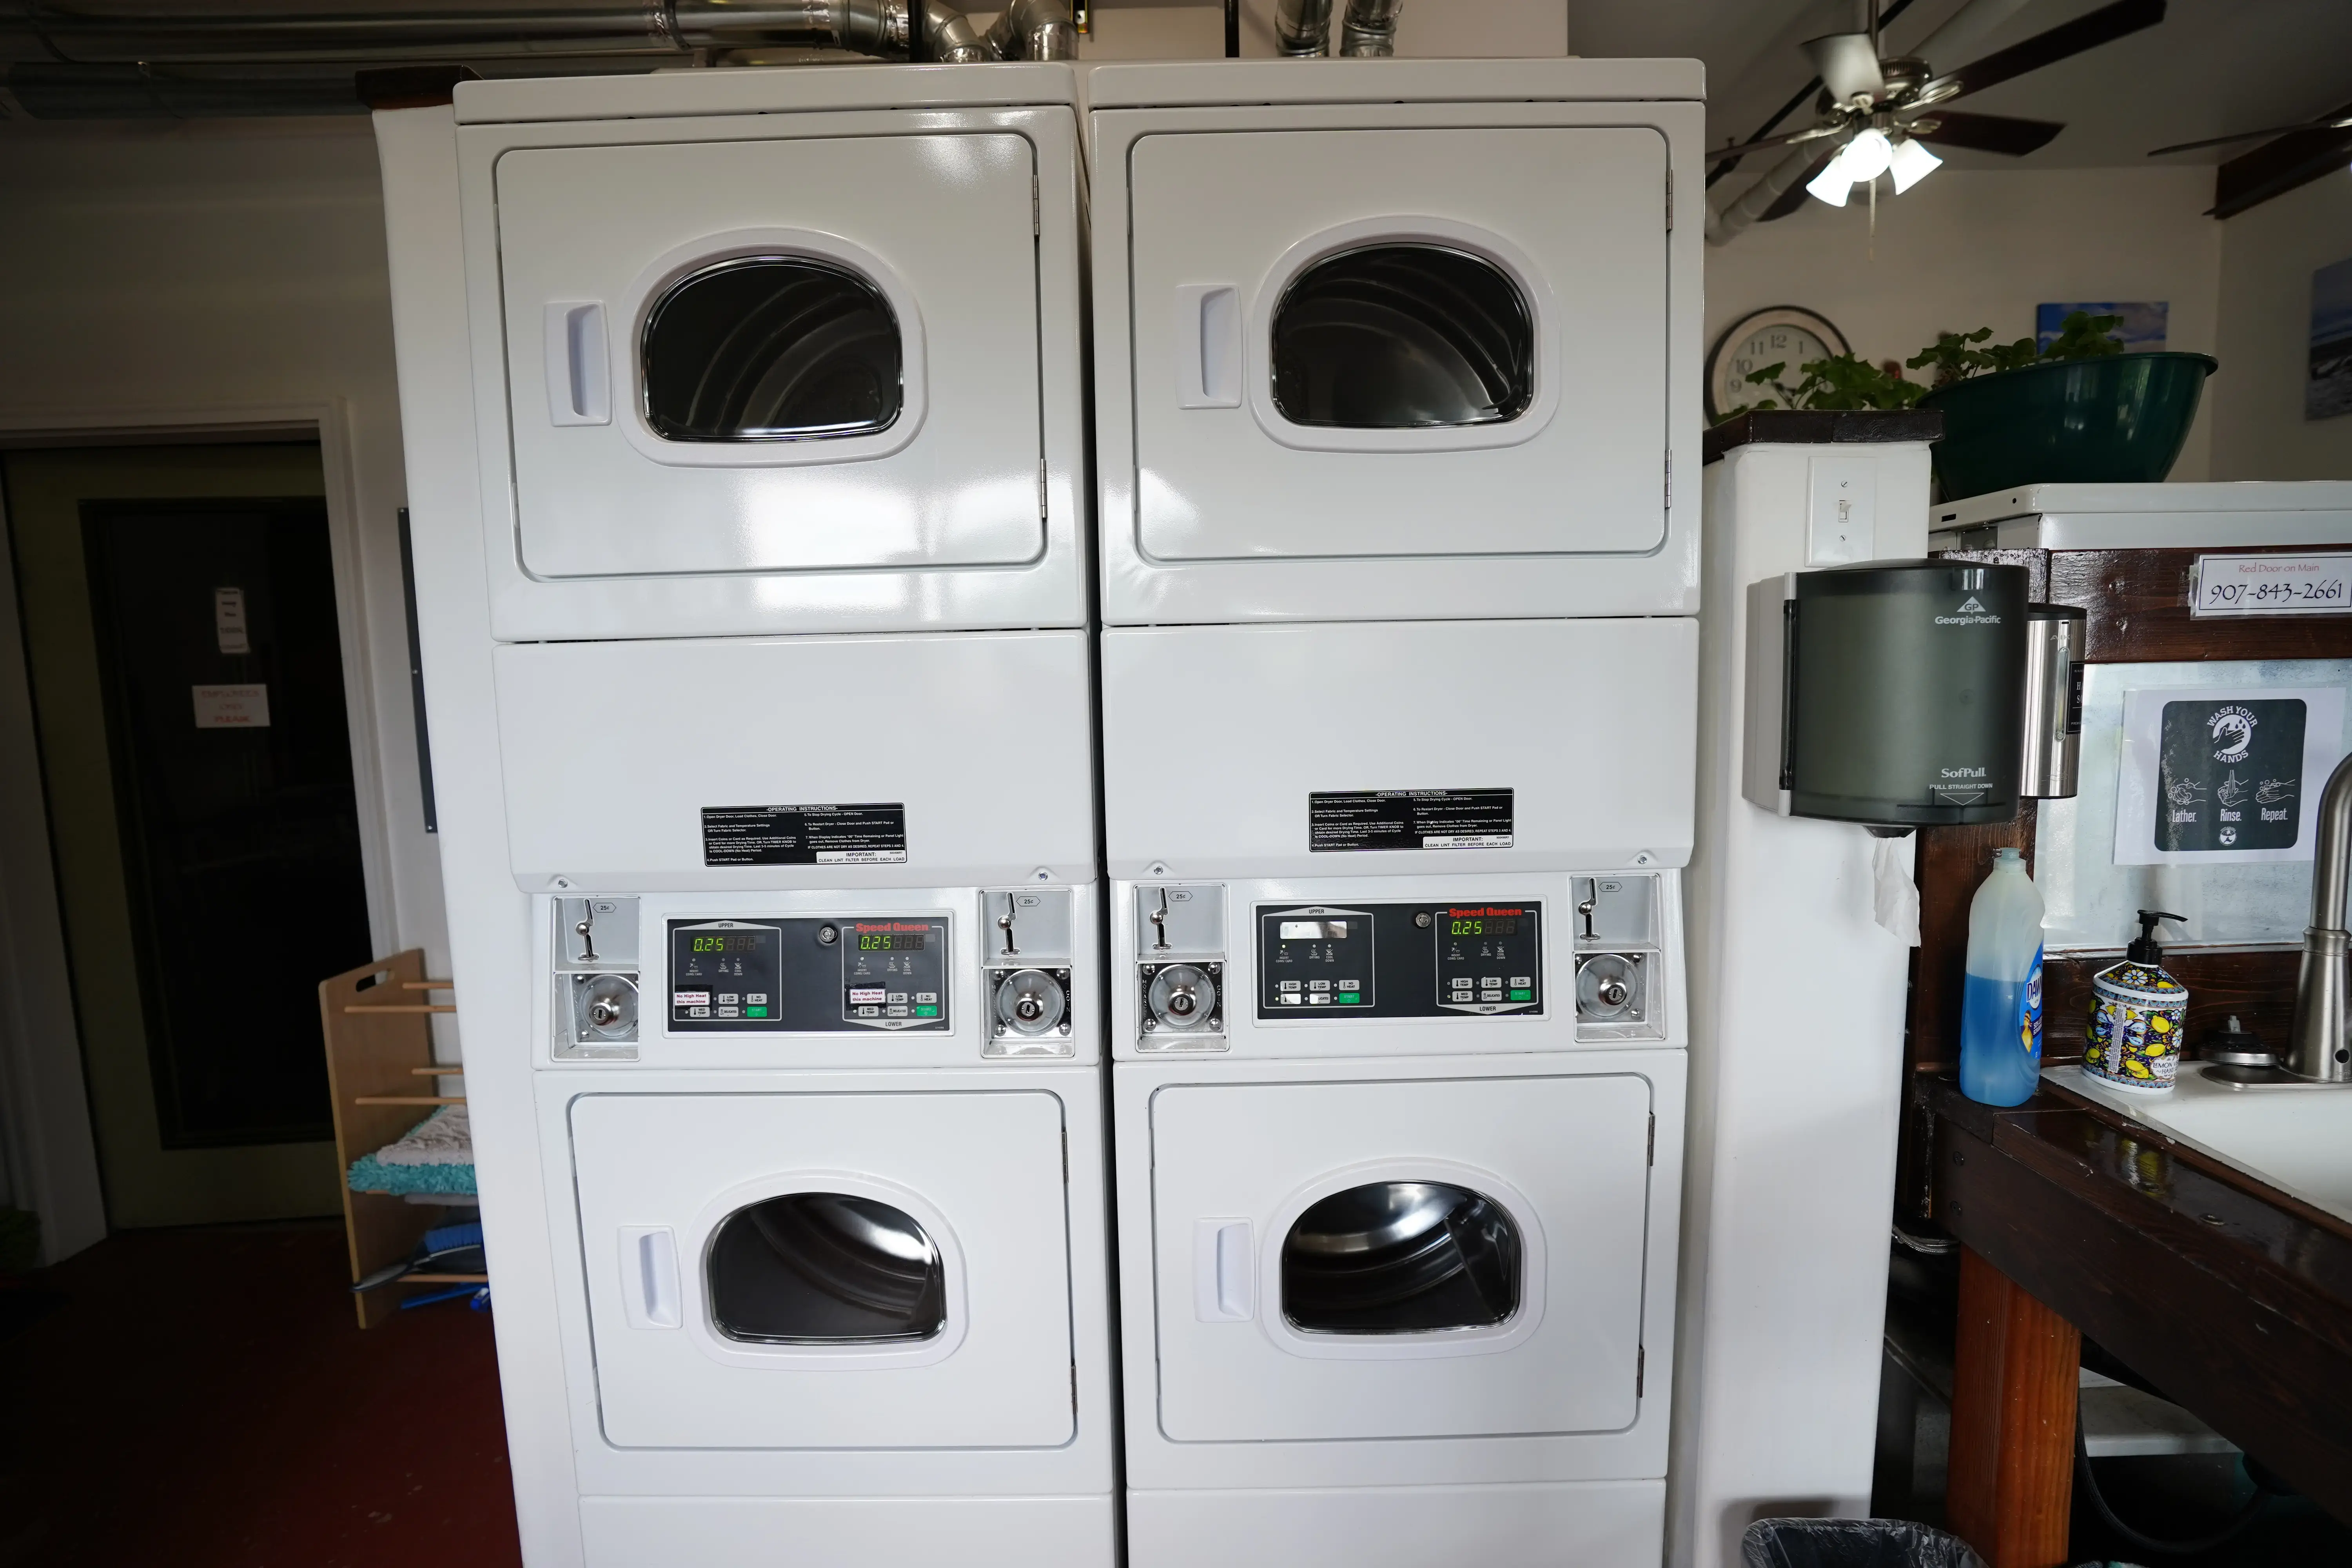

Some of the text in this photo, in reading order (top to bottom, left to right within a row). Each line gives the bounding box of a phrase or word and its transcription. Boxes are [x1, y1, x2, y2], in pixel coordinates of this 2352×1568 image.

[1750, 341, 1763, 355] 11
[1770, 335, 1787, 349] 12
[1798, 341, 1803, 354] 1
[1736, 359, 1753, 375] 10
[1730, 379, 1742, 393] 9
[2239, 563, 2256, 572] Red
[2298, 563, 2319, 572] Main
[2209, 579, 2342, 604] 907-843-2661
[1935, 615, 2001, 626] Georgia-Pacific
[2207, 706, 2258, 728] WASH YOUR
[2213, 750, 2249, 763] HANDS
[2172, 809, 2197, 823] Lather.
[2220, 808, 2242, 822] Rinse.
[2261, 808, 2288, 822] Repeat.
[1449, 907, 1522, 918] Speed Queen
[856, 922, 929, 933] Speed Queen
[1452, 921, 1482, 934] 0.25
[693, 938, 724, 951] 0.25
[860, 936, 891, 949] 0.25
